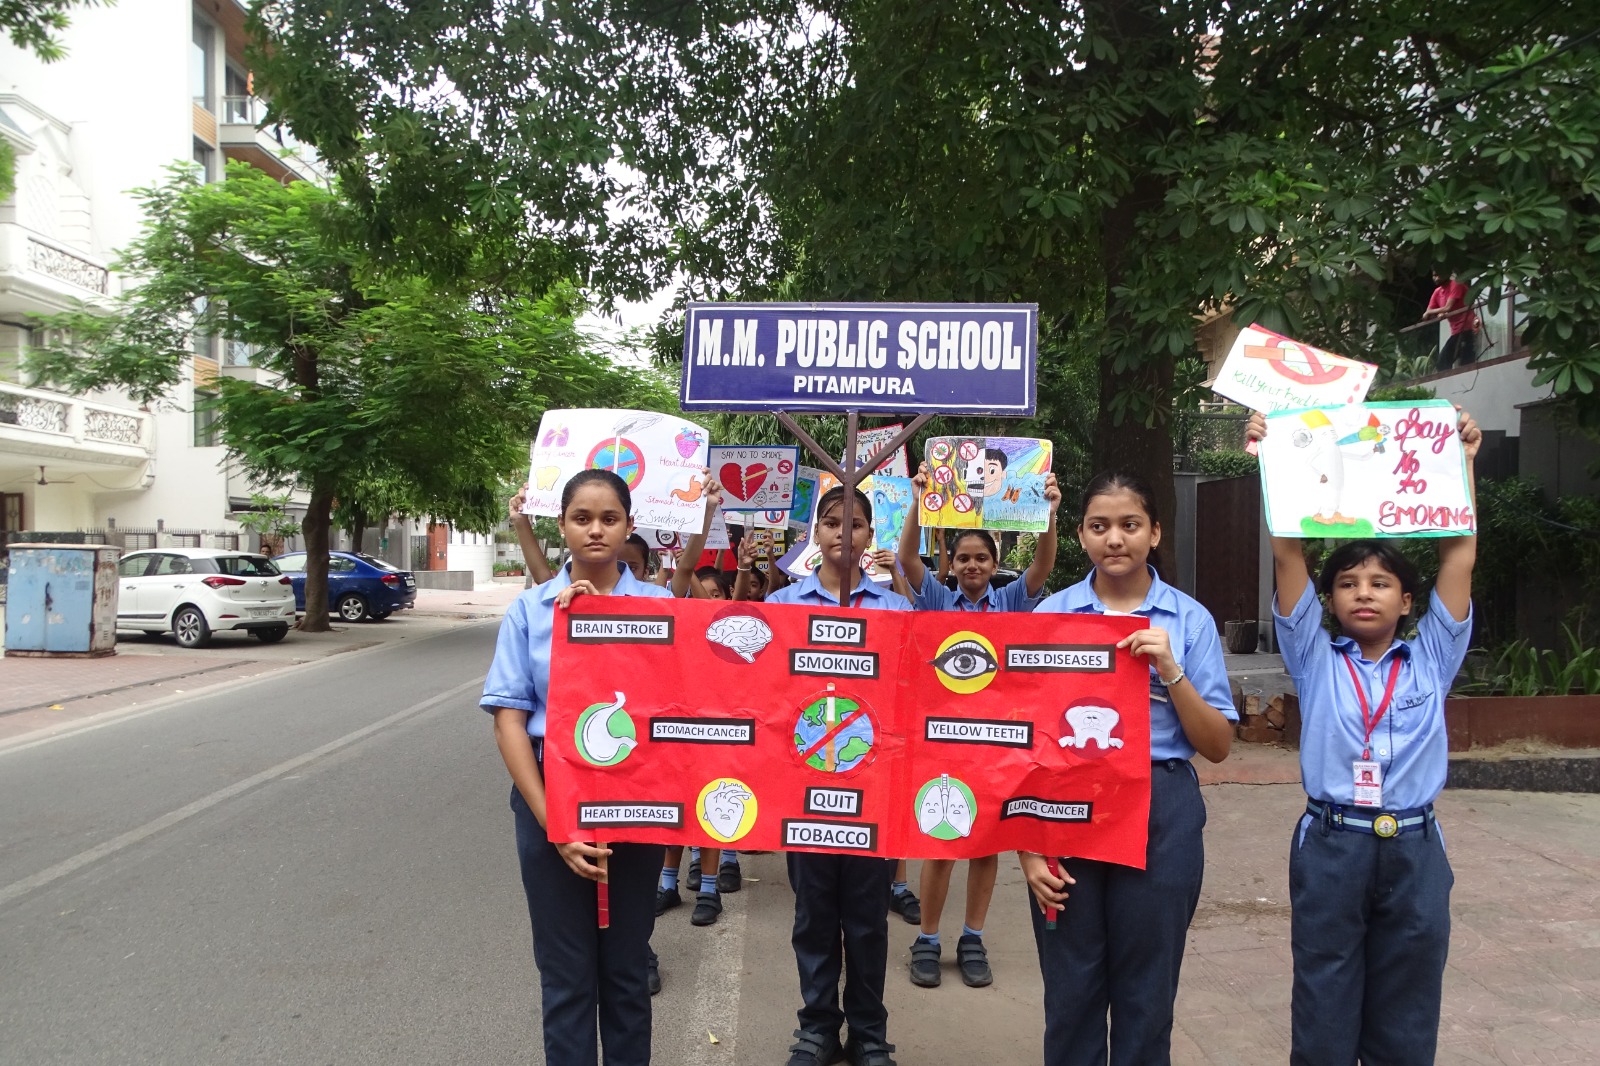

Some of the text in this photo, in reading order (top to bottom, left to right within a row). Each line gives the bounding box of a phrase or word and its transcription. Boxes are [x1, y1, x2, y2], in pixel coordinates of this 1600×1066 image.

[696, 318, 1022, 371] M.M. PUBLIC SCHOOL
[793, 375, 916, 396] PITAMPURA
[1393, 407, 1455, 454] Say
[660, 456, 680, 467] Heart
[721, 450, 784, 460] SAY NO TO SMOKE
[1378, 500, 1475, 531] SMOKING
[574, 622, 664, 636] BRAIN STROKE
[814, 622, 859, 640] STOP
[796, 654, 872, 673] SMOKING
[1010, 653, 1104, 668] EYES DISEASES
[655, 724, 748, 739] STOMACH CANCER
[931, 723, 1026, 741] YELLOW TEETH
[813, 792, 856, 812] QUIT
[1008, 800, 1086, 817] LUNG CANCER
[583, 807, 675, 821] HEART DISEASES
[788, 826, 870, 848] TOBACCO
